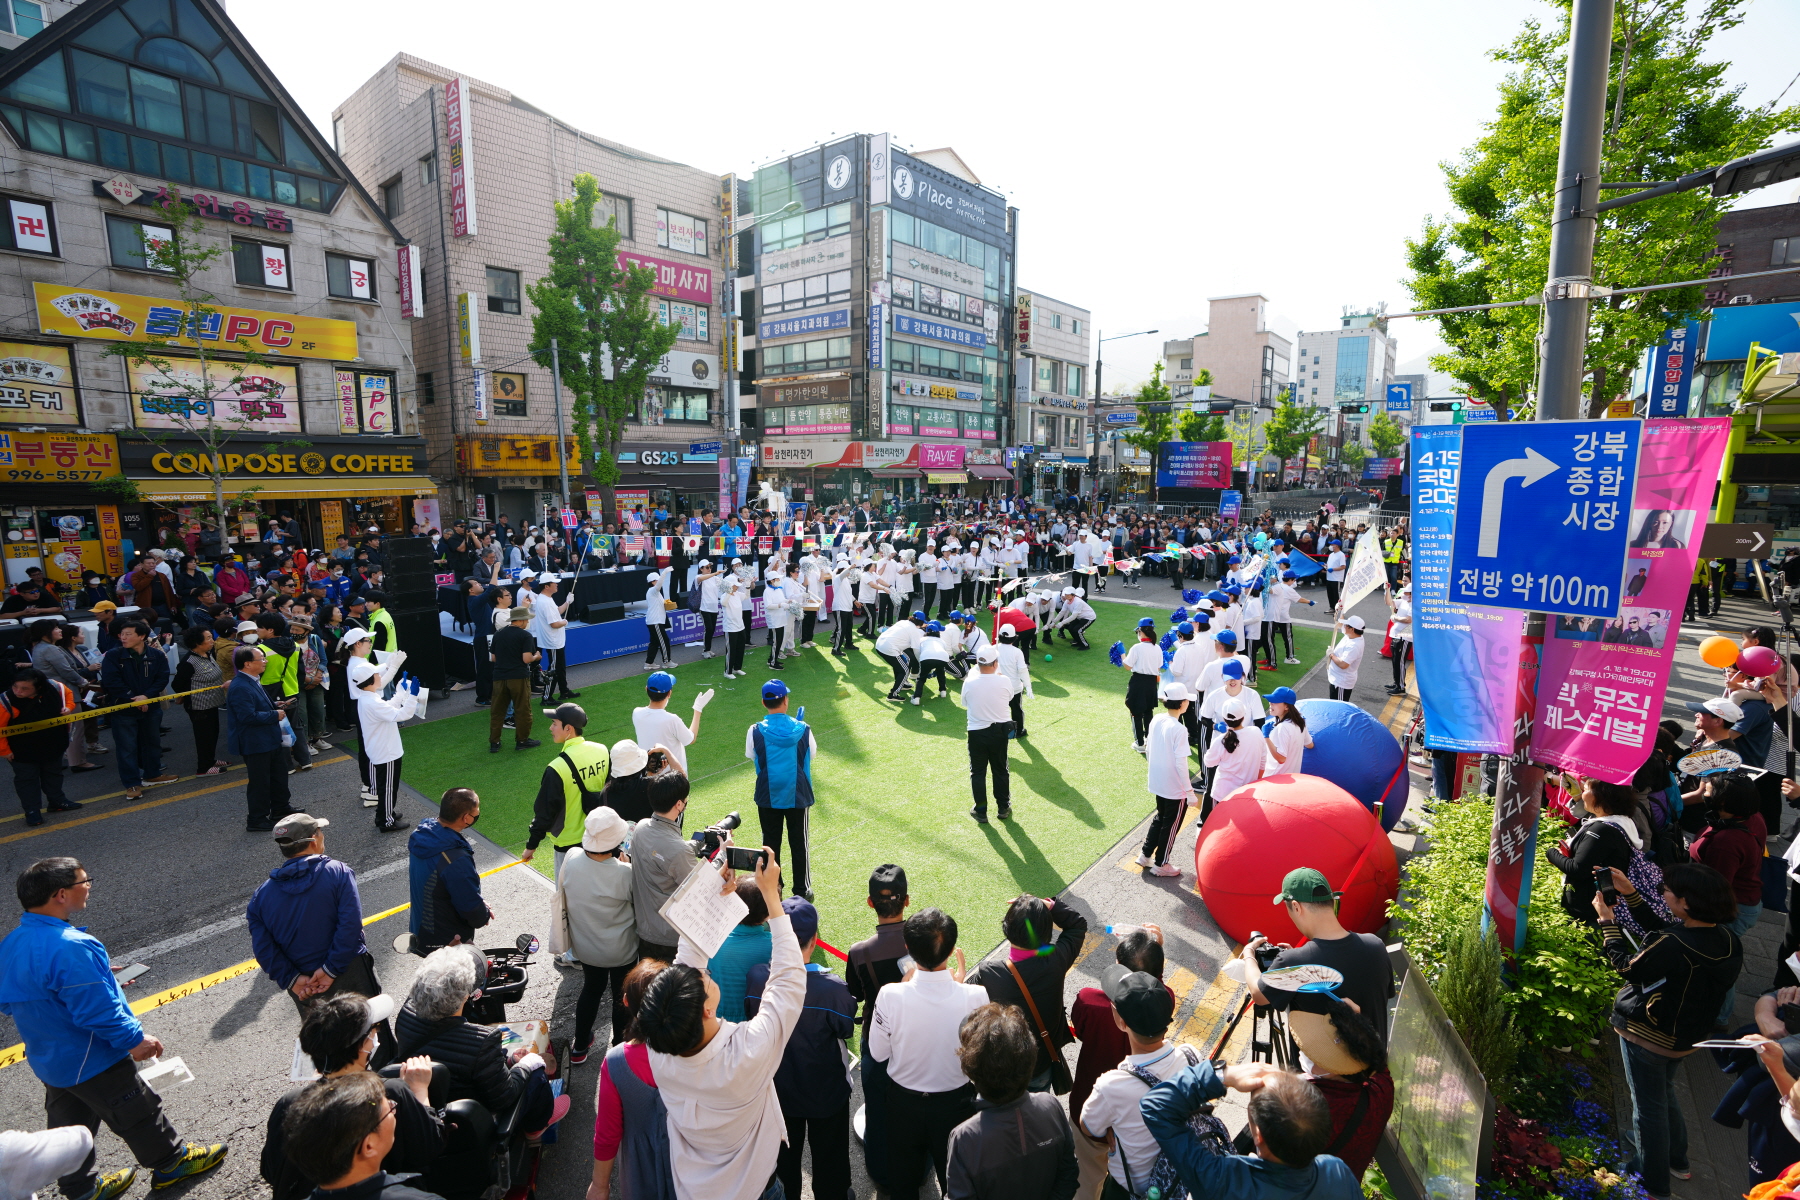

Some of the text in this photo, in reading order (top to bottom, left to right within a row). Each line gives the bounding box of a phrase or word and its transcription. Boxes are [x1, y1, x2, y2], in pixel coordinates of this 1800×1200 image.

[447, 81, 465, 225] 스포츠발마사지
[111, 180, 132, 190] 24시
[112, 187, 133, 198] 영업
[918, 181, 953, 210] Place
[153, 185, 292, 232] 성인용품
[670, 223, 694, 239] 보리사
[265, 256, 286, 276] 황
[350, 270, 367, 287] 궁
[673, 305, 695, 316] 스포츠
[460, 303, 469, 349] 보리사
[698, 310, 707, 338] 아로마
[773, 315, 830, 335] 강북서울치과의원
[913, 321, 971, 344] 강북서울치과의원
[1018, 308, 1030, 343] 노래방
[872, 307, 880, 363] 강북서울치과의원
[301, 341, 316, 351] 2F
[337, 372, 353, 383] 24시
[1660, 328, 1687, 412] 동서통합의원
[364, 376, 386, 389] 홈런
[0, 386, 62, 410] 포커
[785, 385, 829, 402] 명가한의원
[240, 400, 287, 421] 맞고
[341, 384, 356, 427] 연중무휴
[798, 409, 812, 421] 한약
[834, 407, 849, 419] 비만
[871, 387, 880, 430] 한의원
[895, 409, 909, 422] 한약
[1388, 401, 1410, 410] 비보호
[1611, 402, 1631, 413] 금
[771, 411, 777, 423] 침
[926, 411, 953, 423] 교통사고
[14, 441, 114, 468] 부동산
[927, 449, 956, 462] RAVIE
[1571, 430, 1629, 462] 강북
[151, 452, 415, 474] COMPOSE COFFEE
[641, 450, 678, 466] GS25
[7, 469, 103, 481] 996-5577
[1566, 465, 1625, 497] 종합
[124, 514, 140, 522] 1055
[1562, 500, 1620, 531] 시장
[1457, 569, 1503, 600] 전방
[1618, 674, 1654, 687] 메인무대
[1630, 668, 1657, 679] 19:00
[1556, 682, 1580, 707] 락
[1593, 686, 1651, 720] 뮤직
[1543, 704, 1646, 748] 페스티벌
